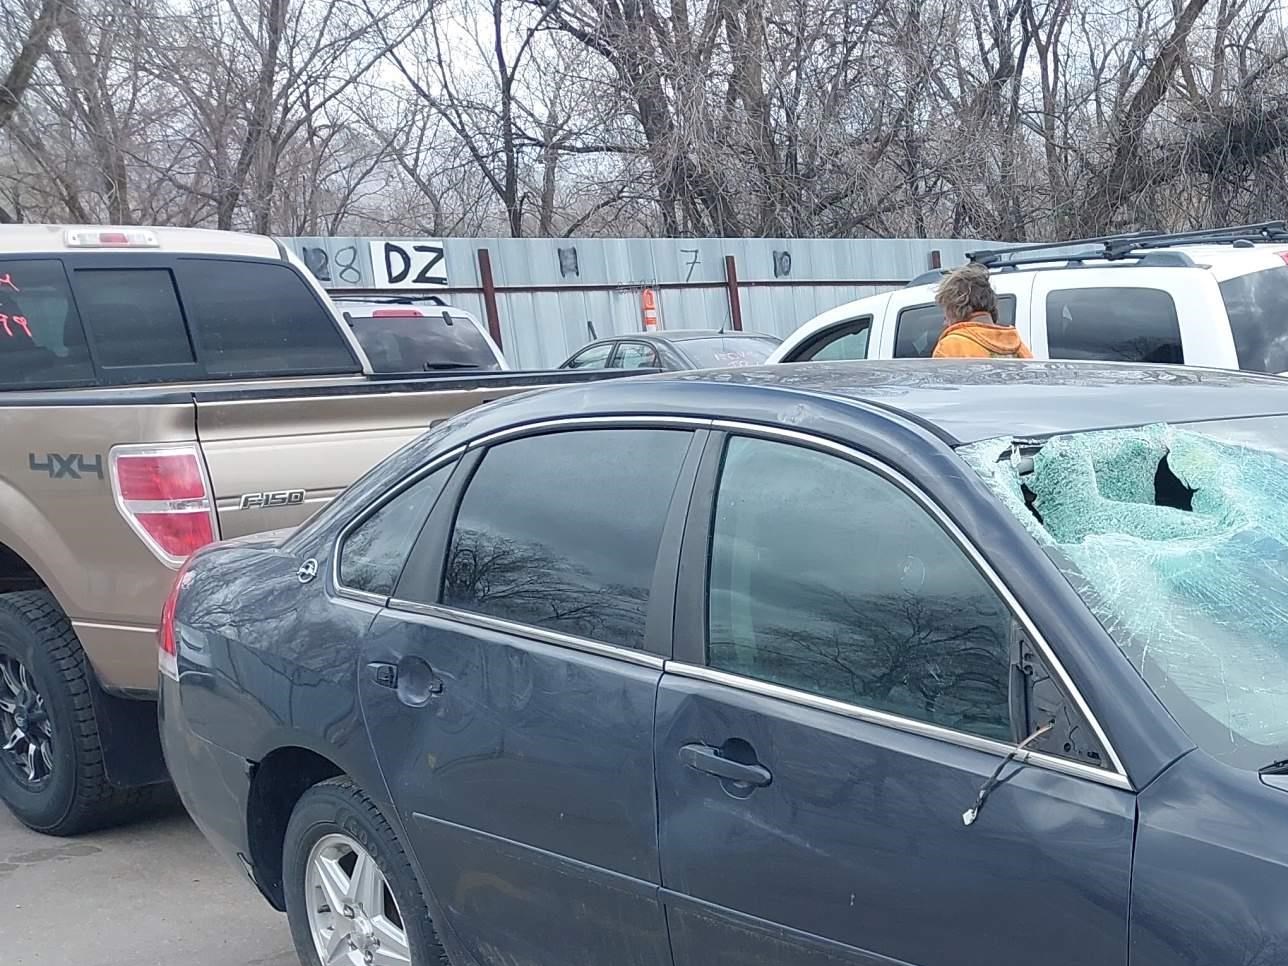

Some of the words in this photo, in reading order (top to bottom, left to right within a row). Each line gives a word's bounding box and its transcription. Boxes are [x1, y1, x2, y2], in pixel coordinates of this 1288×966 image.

[384, 241, 449, 286] DZ
[679, 249, 701, 282] 7
[239, 488, 306, 510] F-150
